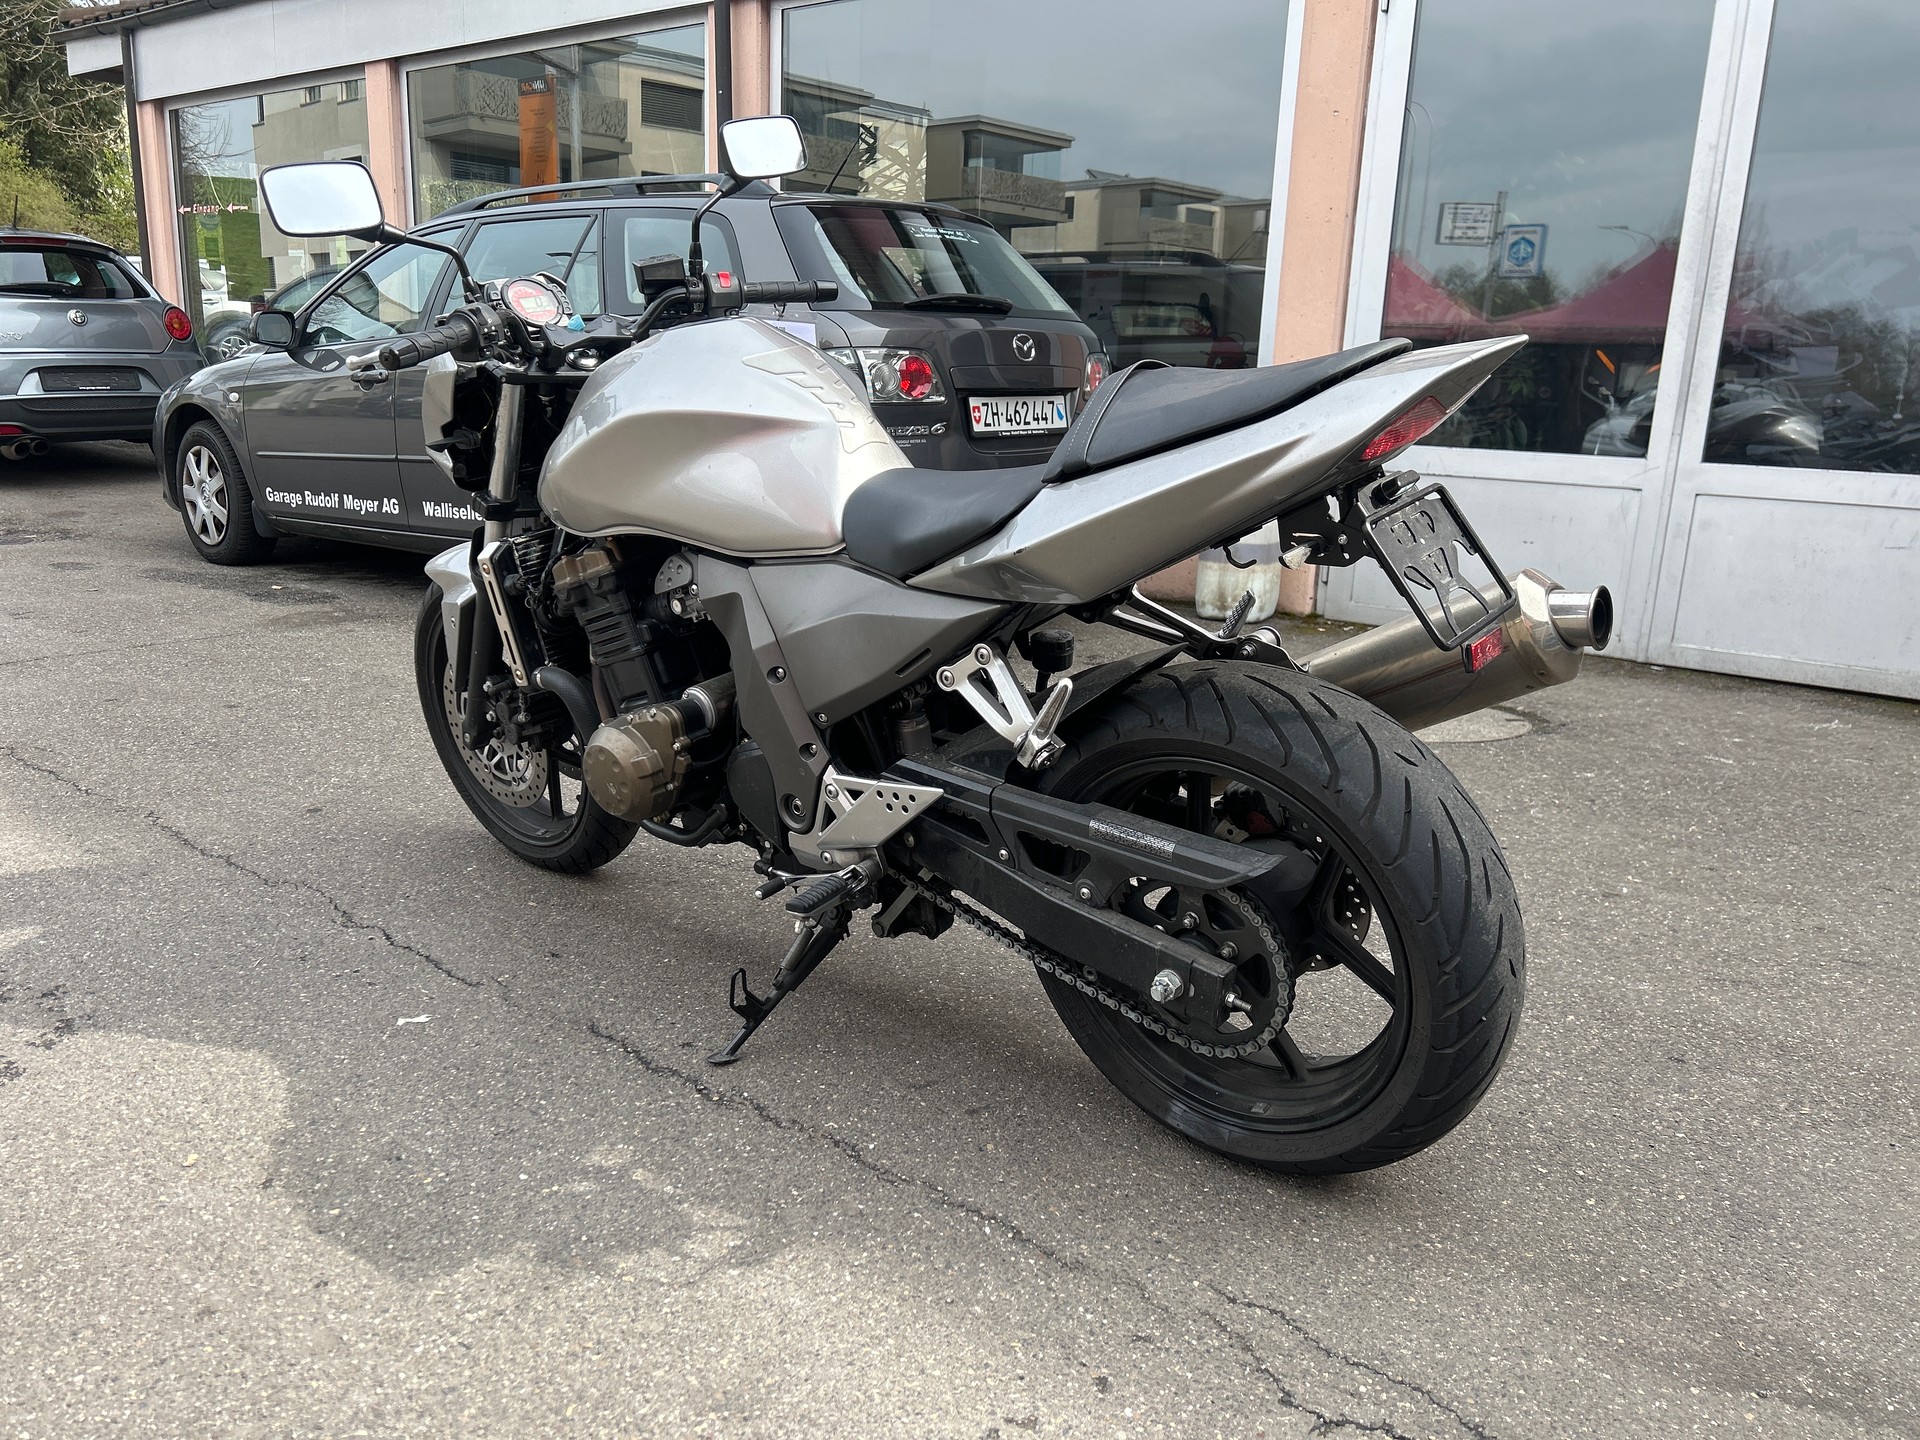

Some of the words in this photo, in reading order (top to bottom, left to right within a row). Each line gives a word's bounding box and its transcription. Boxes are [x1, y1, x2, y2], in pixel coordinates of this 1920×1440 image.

[193, 203, 219, 216] Eingang
[265, 487, 302, 508] Garage
[304, 490, 339, 508] Rudolf
[343, 494, 379, 515] Meyer
[382, 497, 399, 515] AG
[421, 500, 486, 522] Walliselle
